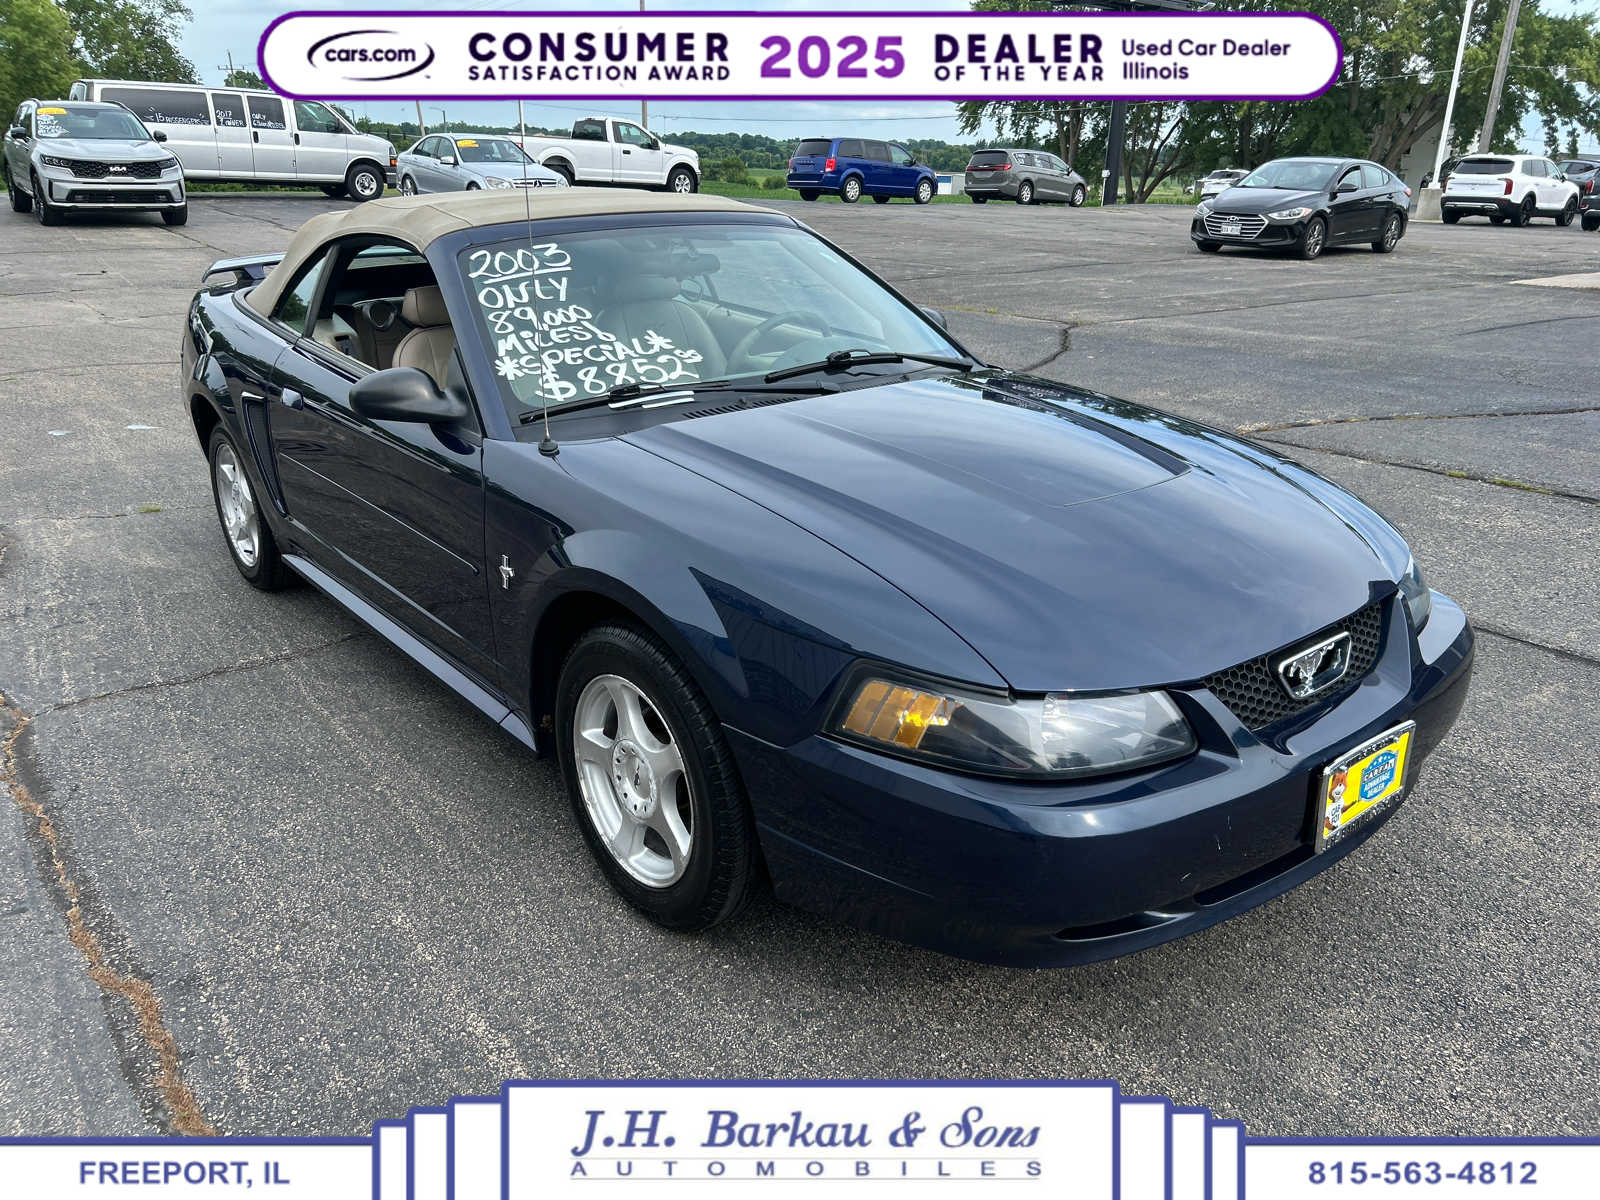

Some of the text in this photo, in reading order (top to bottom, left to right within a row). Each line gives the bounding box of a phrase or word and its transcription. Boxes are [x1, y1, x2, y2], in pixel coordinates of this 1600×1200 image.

[468, 243, 572, 278] 2003
[478, 276, 568, 309] ONLY
[488, 305, 593, 334] 89,000
